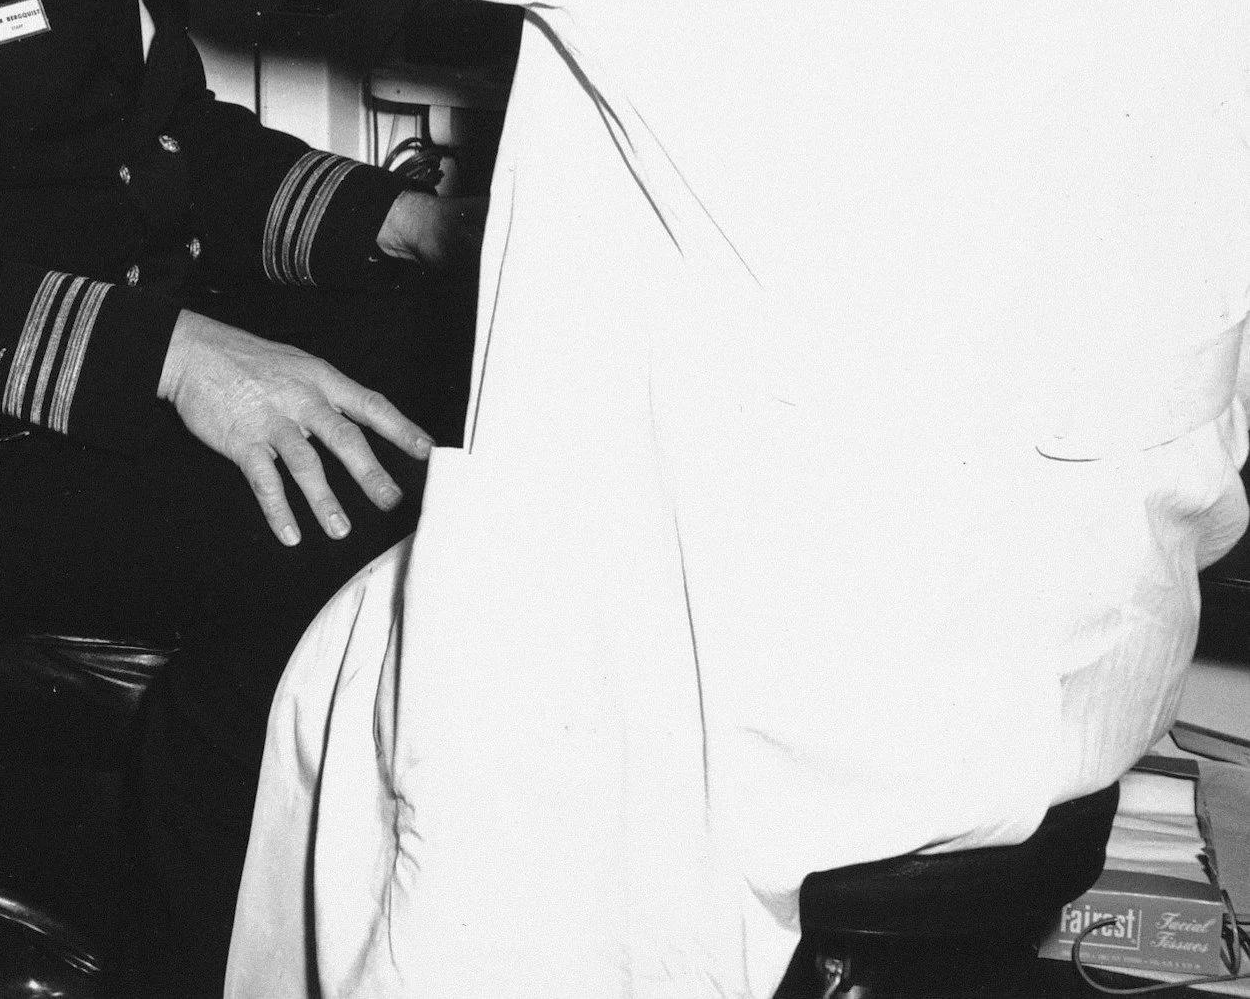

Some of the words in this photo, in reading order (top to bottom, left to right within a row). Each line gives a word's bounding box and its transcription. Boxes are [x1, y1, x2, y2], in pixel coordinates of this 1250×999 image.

[6, 8, 41, 22] BERGQUIST
[1154, 912, 1216, 933] Facial
[1149, 932, 1209, 953] Tissues
